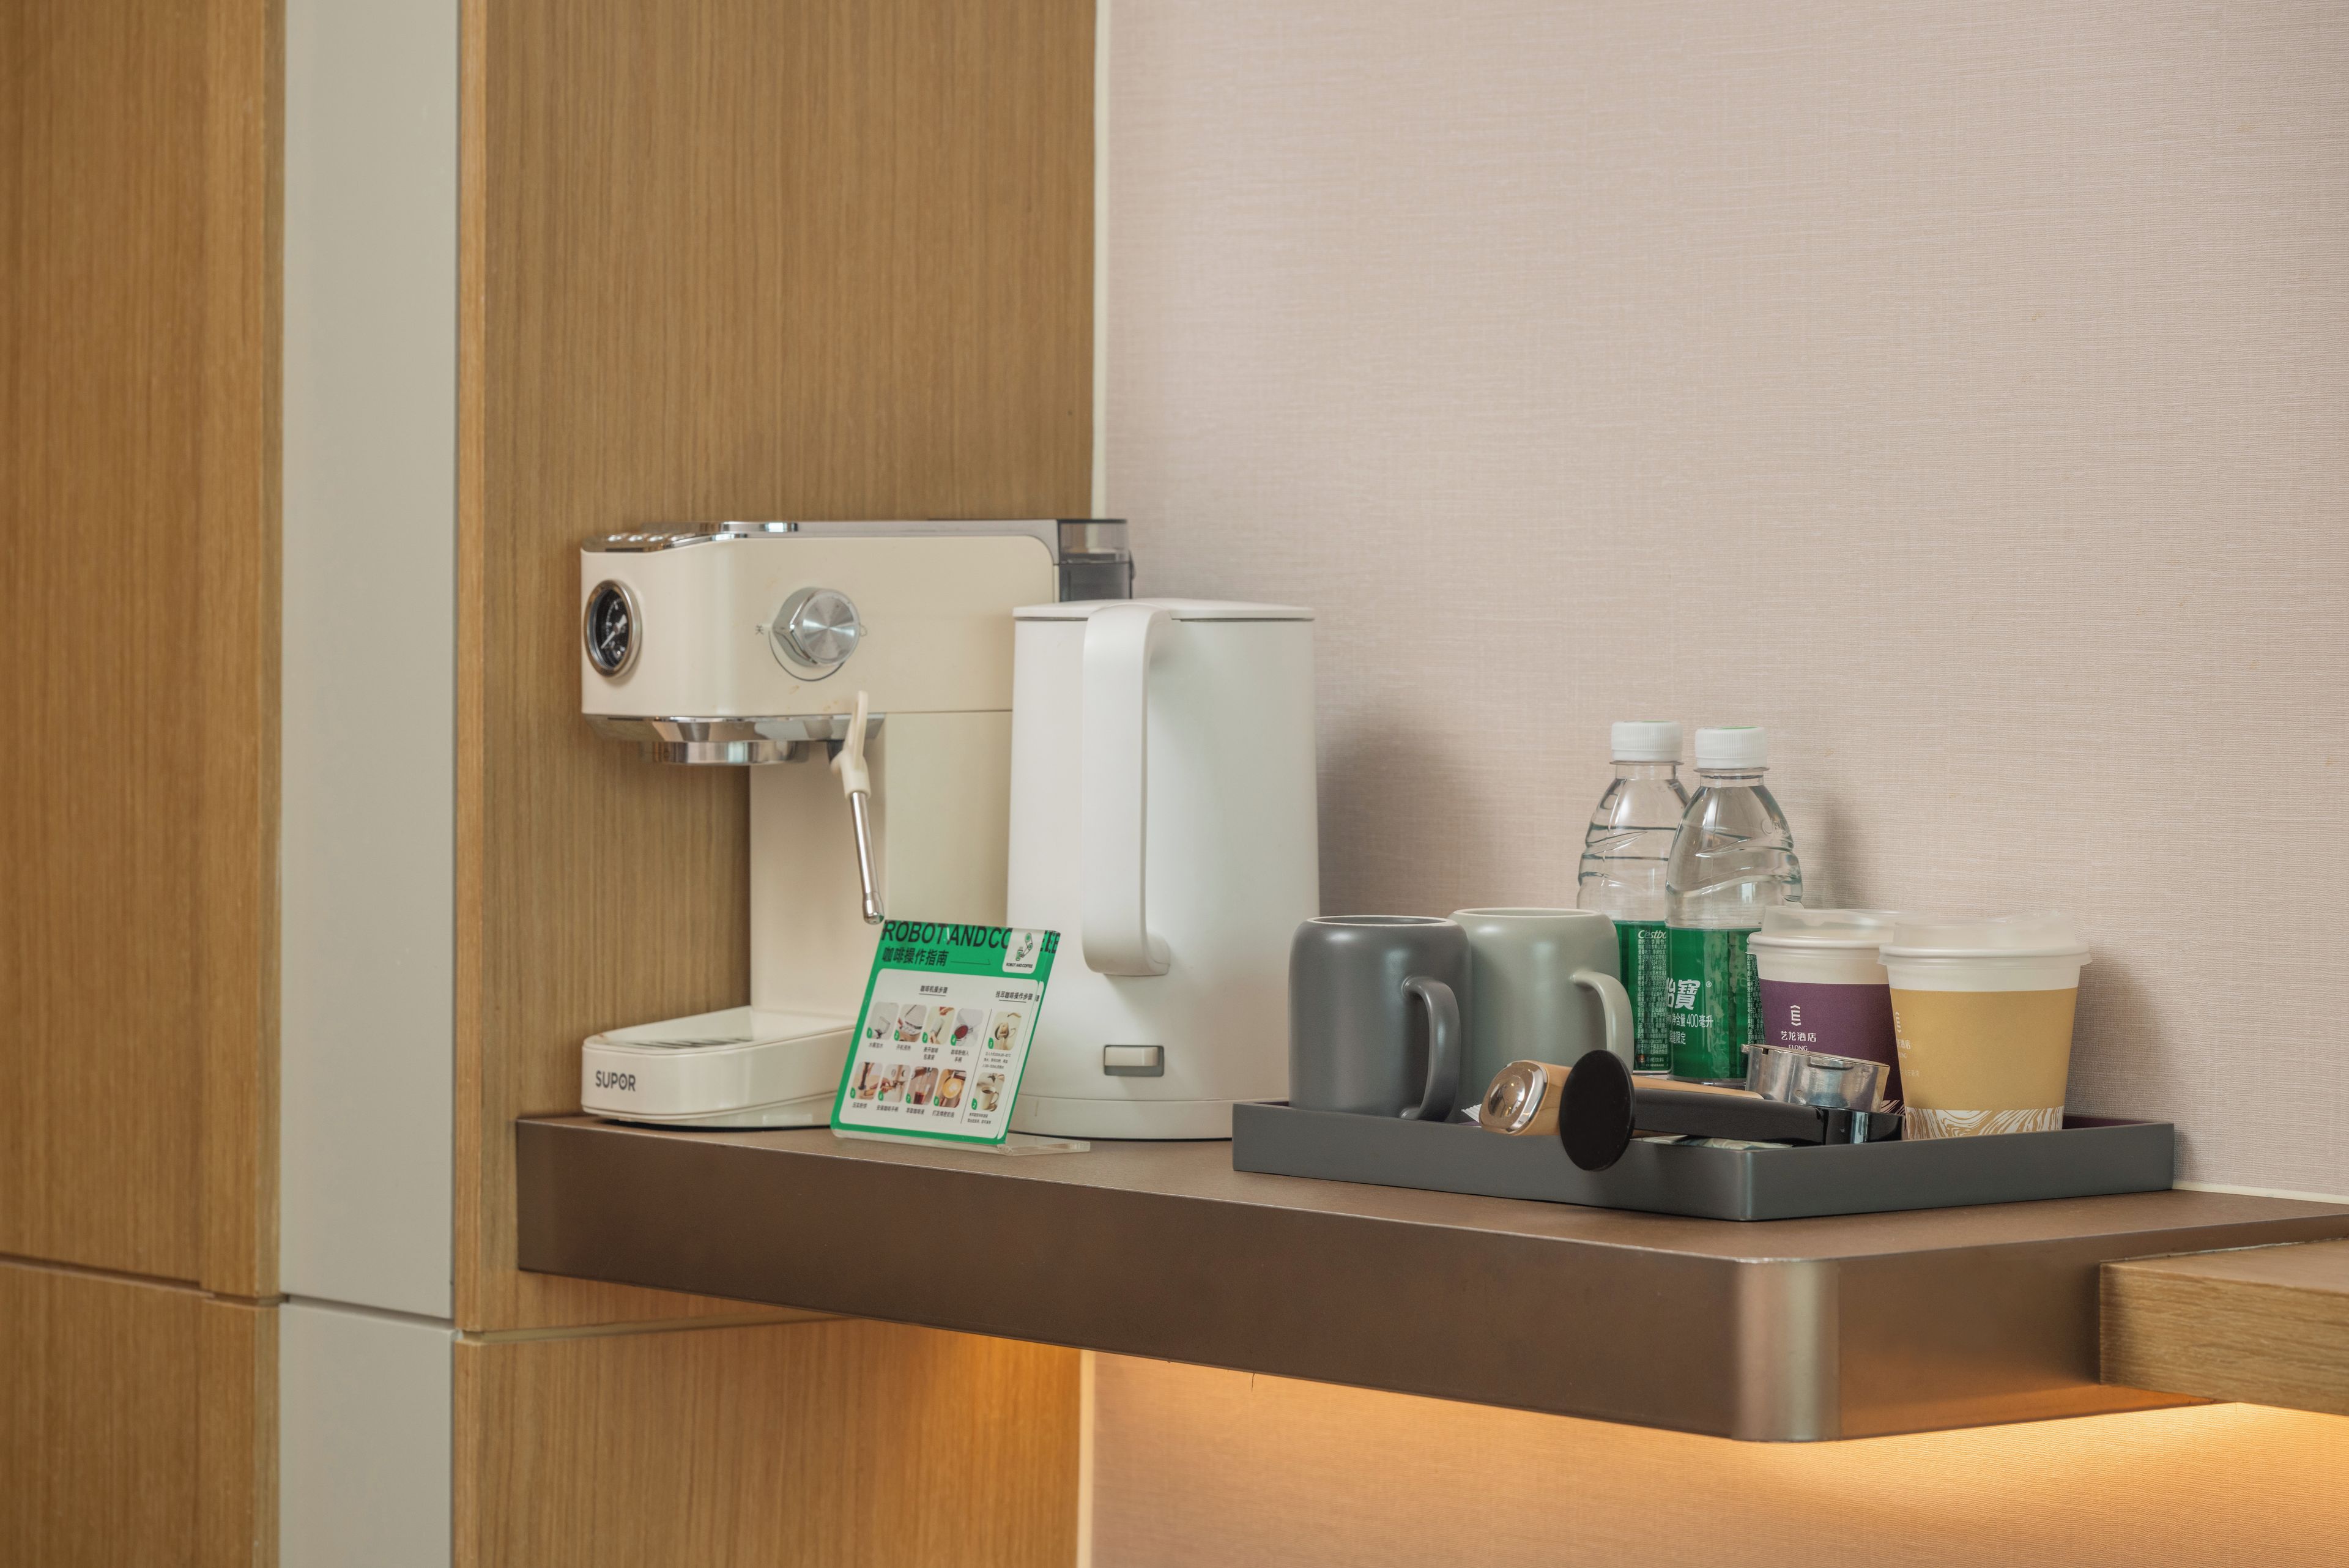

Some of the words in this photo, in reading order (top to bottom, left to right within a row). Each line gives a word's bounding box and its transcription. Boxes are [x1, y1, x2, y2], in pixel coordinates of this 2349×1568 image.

[881, 920, 948, 945] ROBOT
[948, 924, 987, 946] AND
[881, 947, 949, 967] 咖啡操作指南
[1781, 1030, 1817, 1042] 艺龙酒店
[595, 1070, 636, 1091] SUPOR
